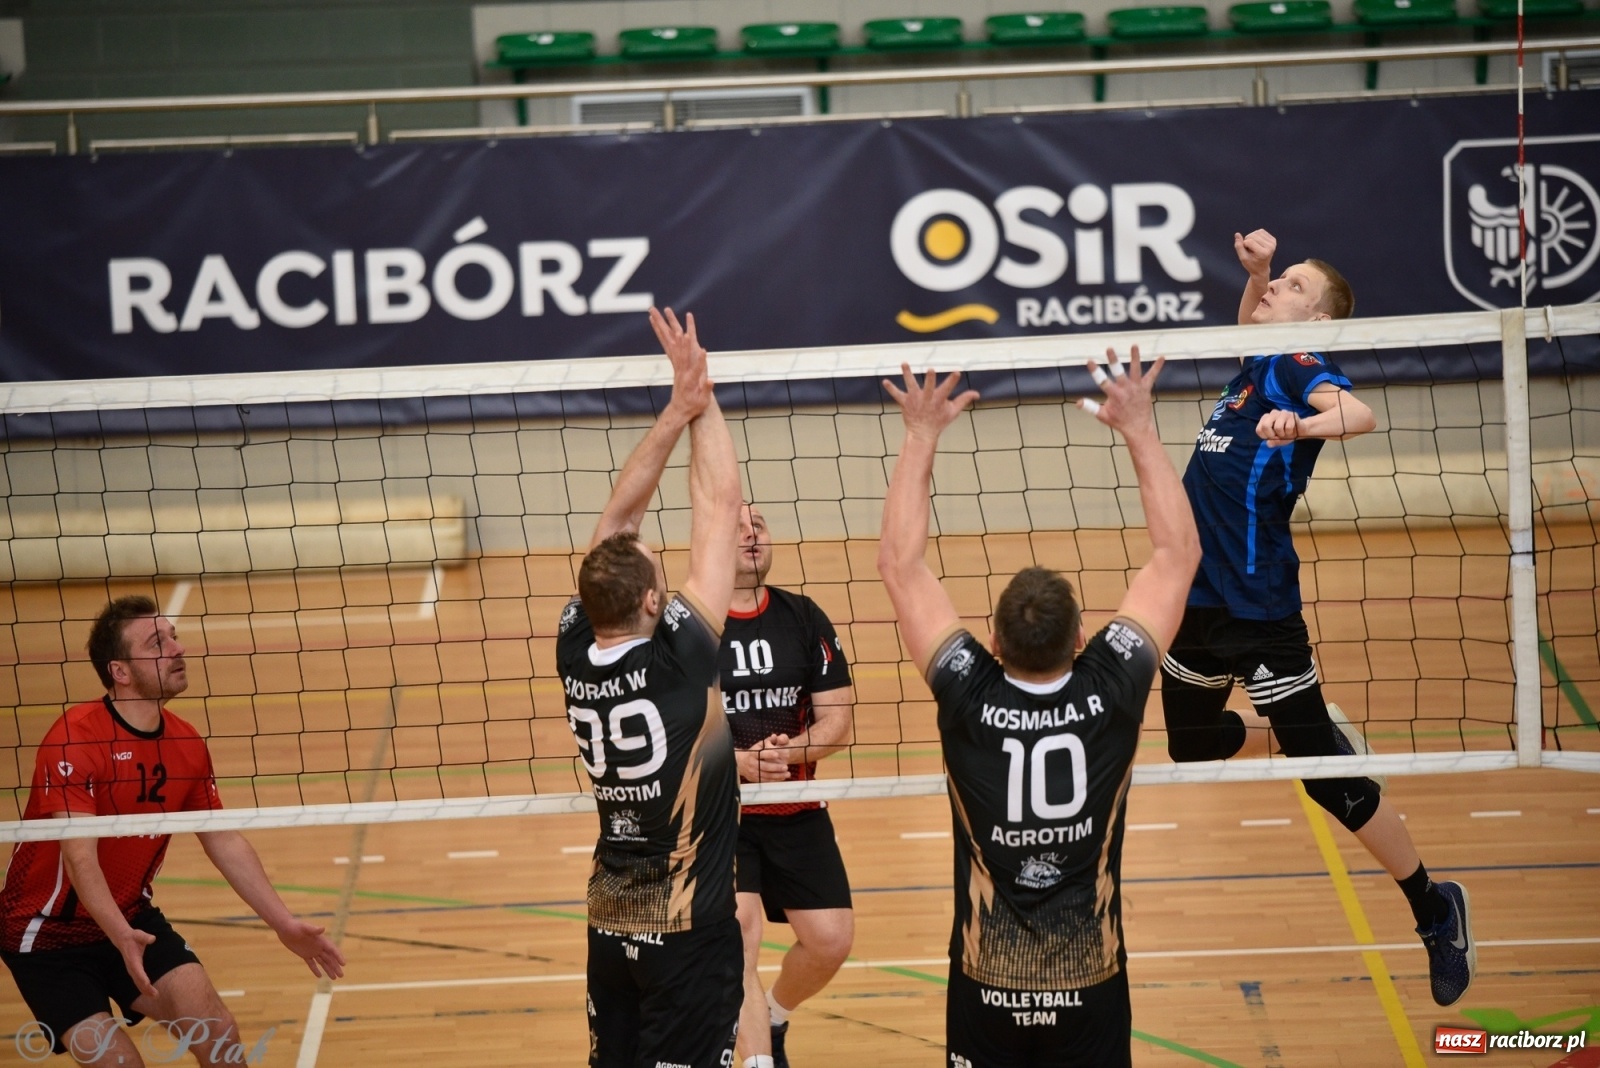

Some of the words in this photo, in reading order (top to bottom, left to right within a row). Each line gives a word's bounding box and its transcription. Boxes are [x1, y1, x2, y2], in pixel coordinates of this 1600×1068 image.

[108, 216, 653, 333] RACIBÓRZ
[1016, 287, 1203, 328] RACIBÓRZ
[730, 639, 774, 677] 10
[625, 668, 647, 691] W
[721, 686, 802, 714] ŁOTNIK
[1087, 694, 1104, 716] R
[568, 699, 668, 779] 99
[136, 763, 167, 803] 12
[593, 780, 661, 802] GROTIM
[1002, 733, 1087, 822] 10
[991, 817, 1093, 847] AGROTIM
[981, 988, 1082, 1008] VOLLEYBALL
[1012, 1011, 1056, 1026] TEAM
